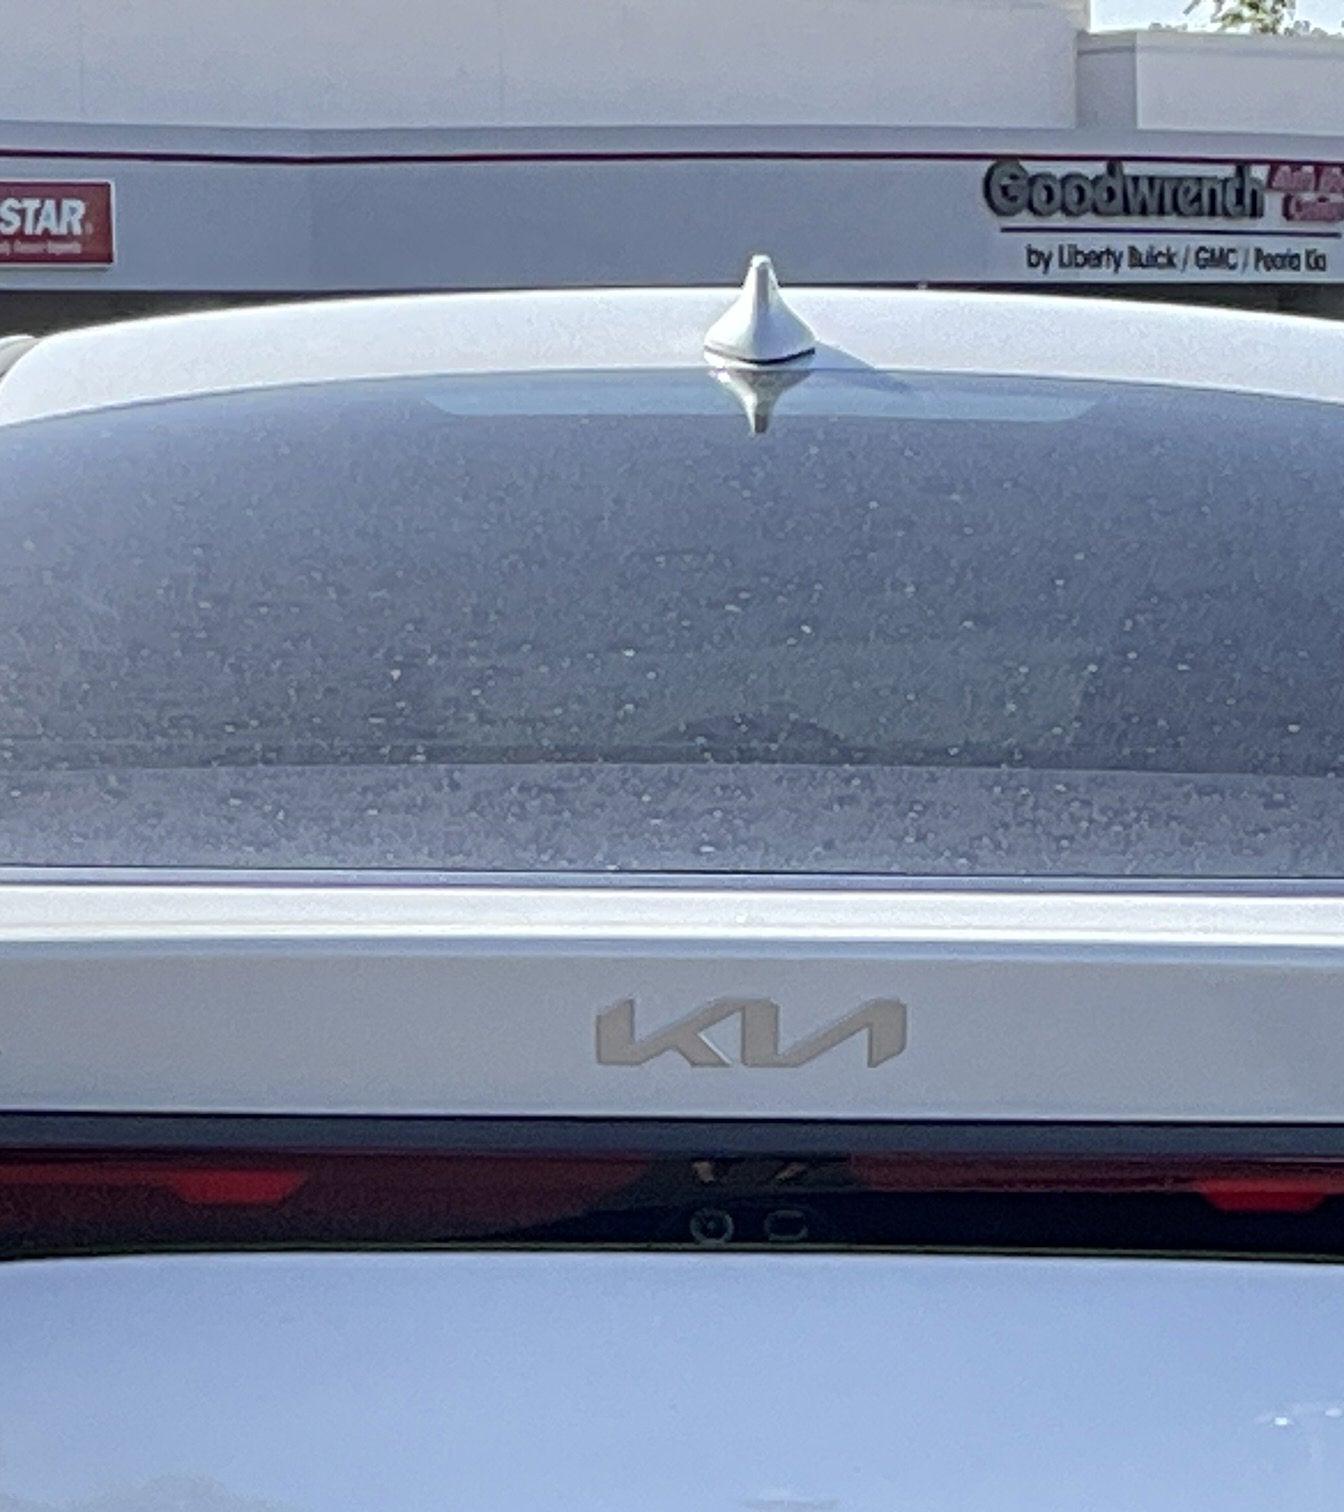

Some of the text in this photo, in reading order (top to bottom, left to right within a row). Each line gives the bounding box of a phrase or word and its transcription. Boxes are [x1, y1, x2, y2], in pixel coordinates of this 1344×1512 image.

[983, 158, 1265, 218] Goodwrench
[1026, 244, 1052, 274] by
[1058, 245, 1123, 274] Liberty
[1127, 246, 1177, 269] Buick
[1194, 247, 1238, 270] GMC
[1254, 248, 1301, 272] Peoria
